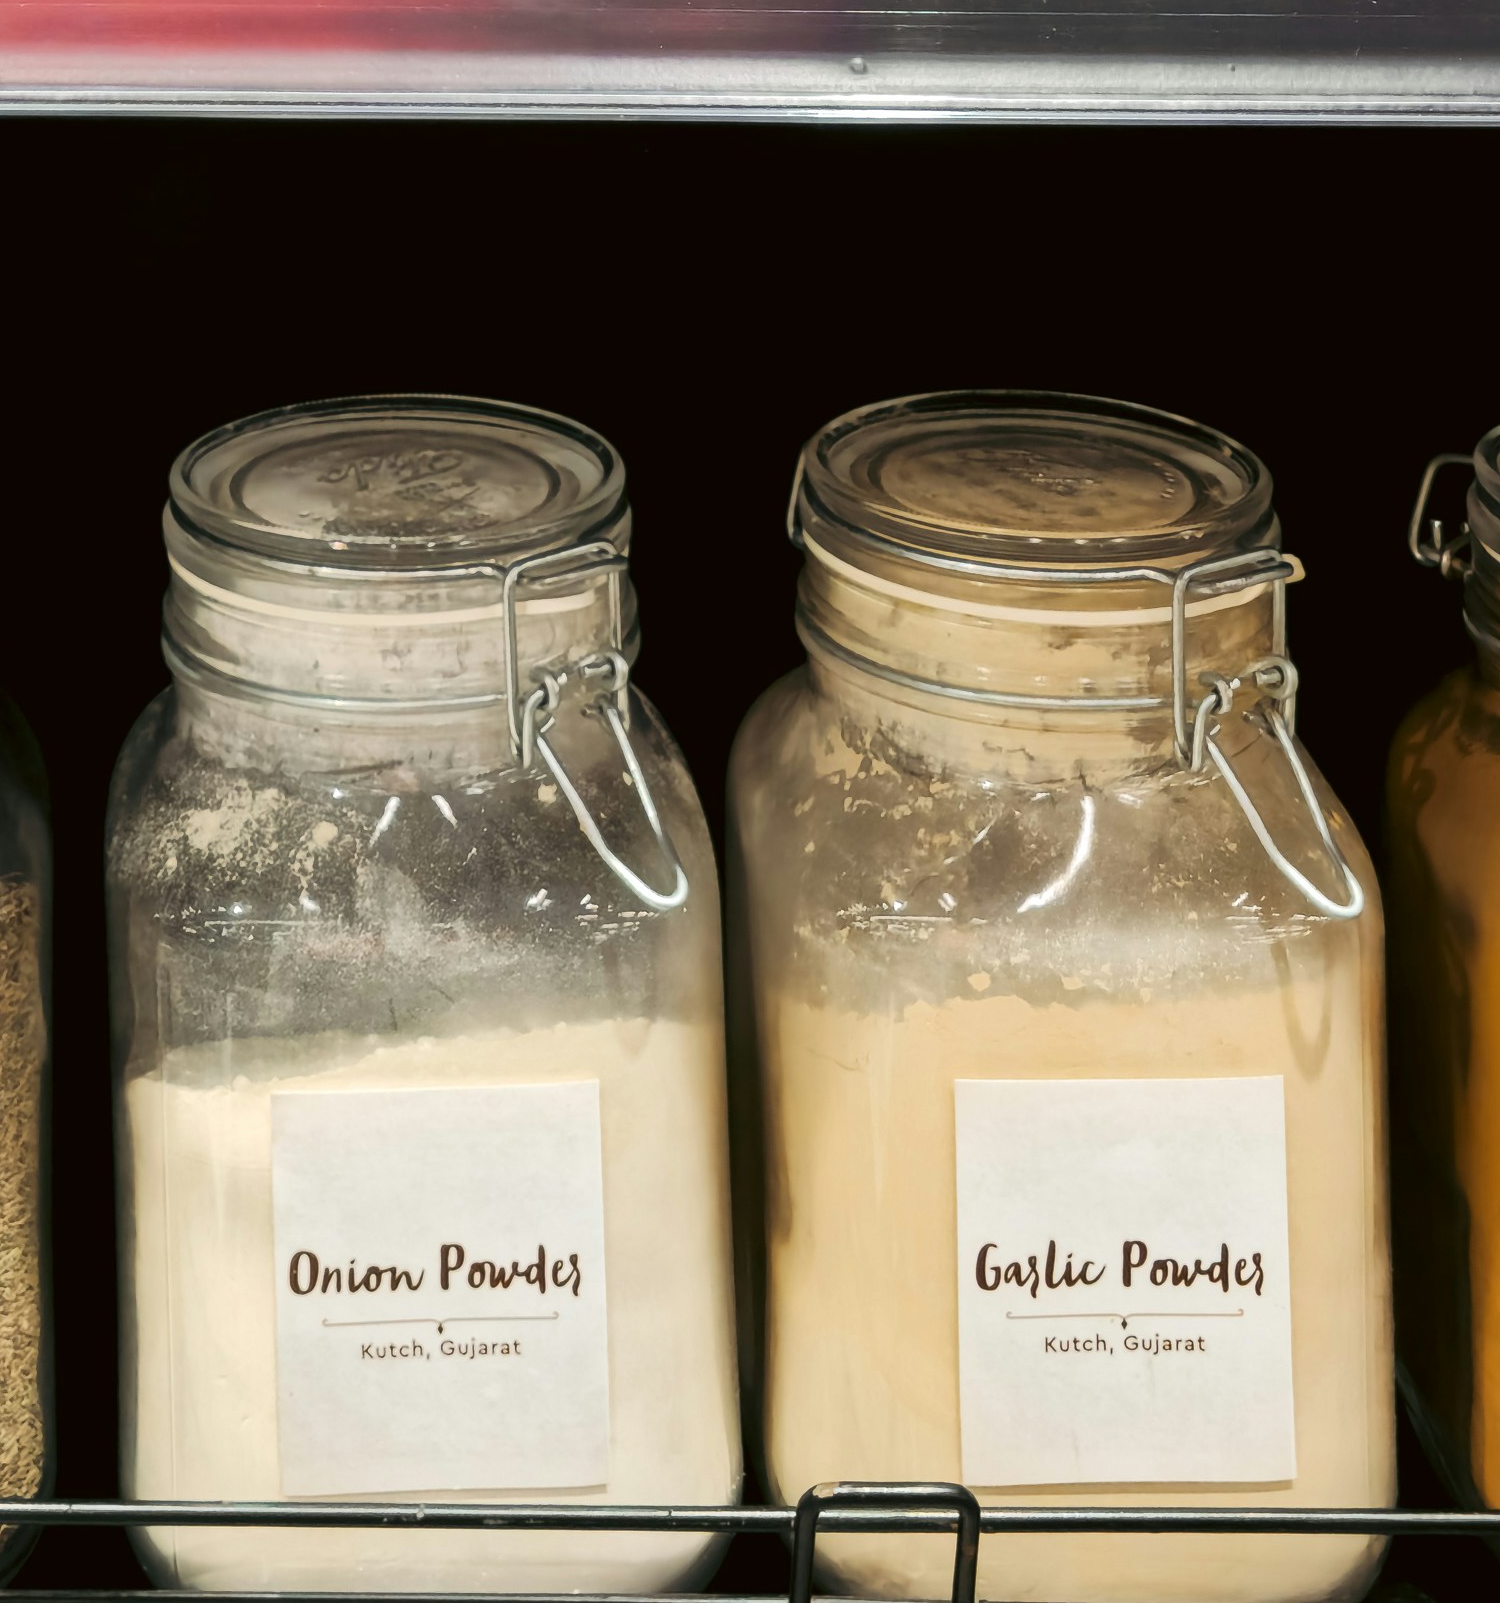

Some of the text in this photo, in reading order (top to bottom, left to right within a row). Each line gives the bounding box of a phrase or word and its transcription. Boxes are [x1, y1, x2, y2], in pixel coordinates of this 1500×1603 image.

[289, 1244, 581, 1297] Onion Powder
[976, 1240, 1264, 1299] Garlic Powder
[361, 1337, 522, 1361] Kutch, Gujarat
[1045, 1333, 1207, 1356] Kutch, Gujarat
